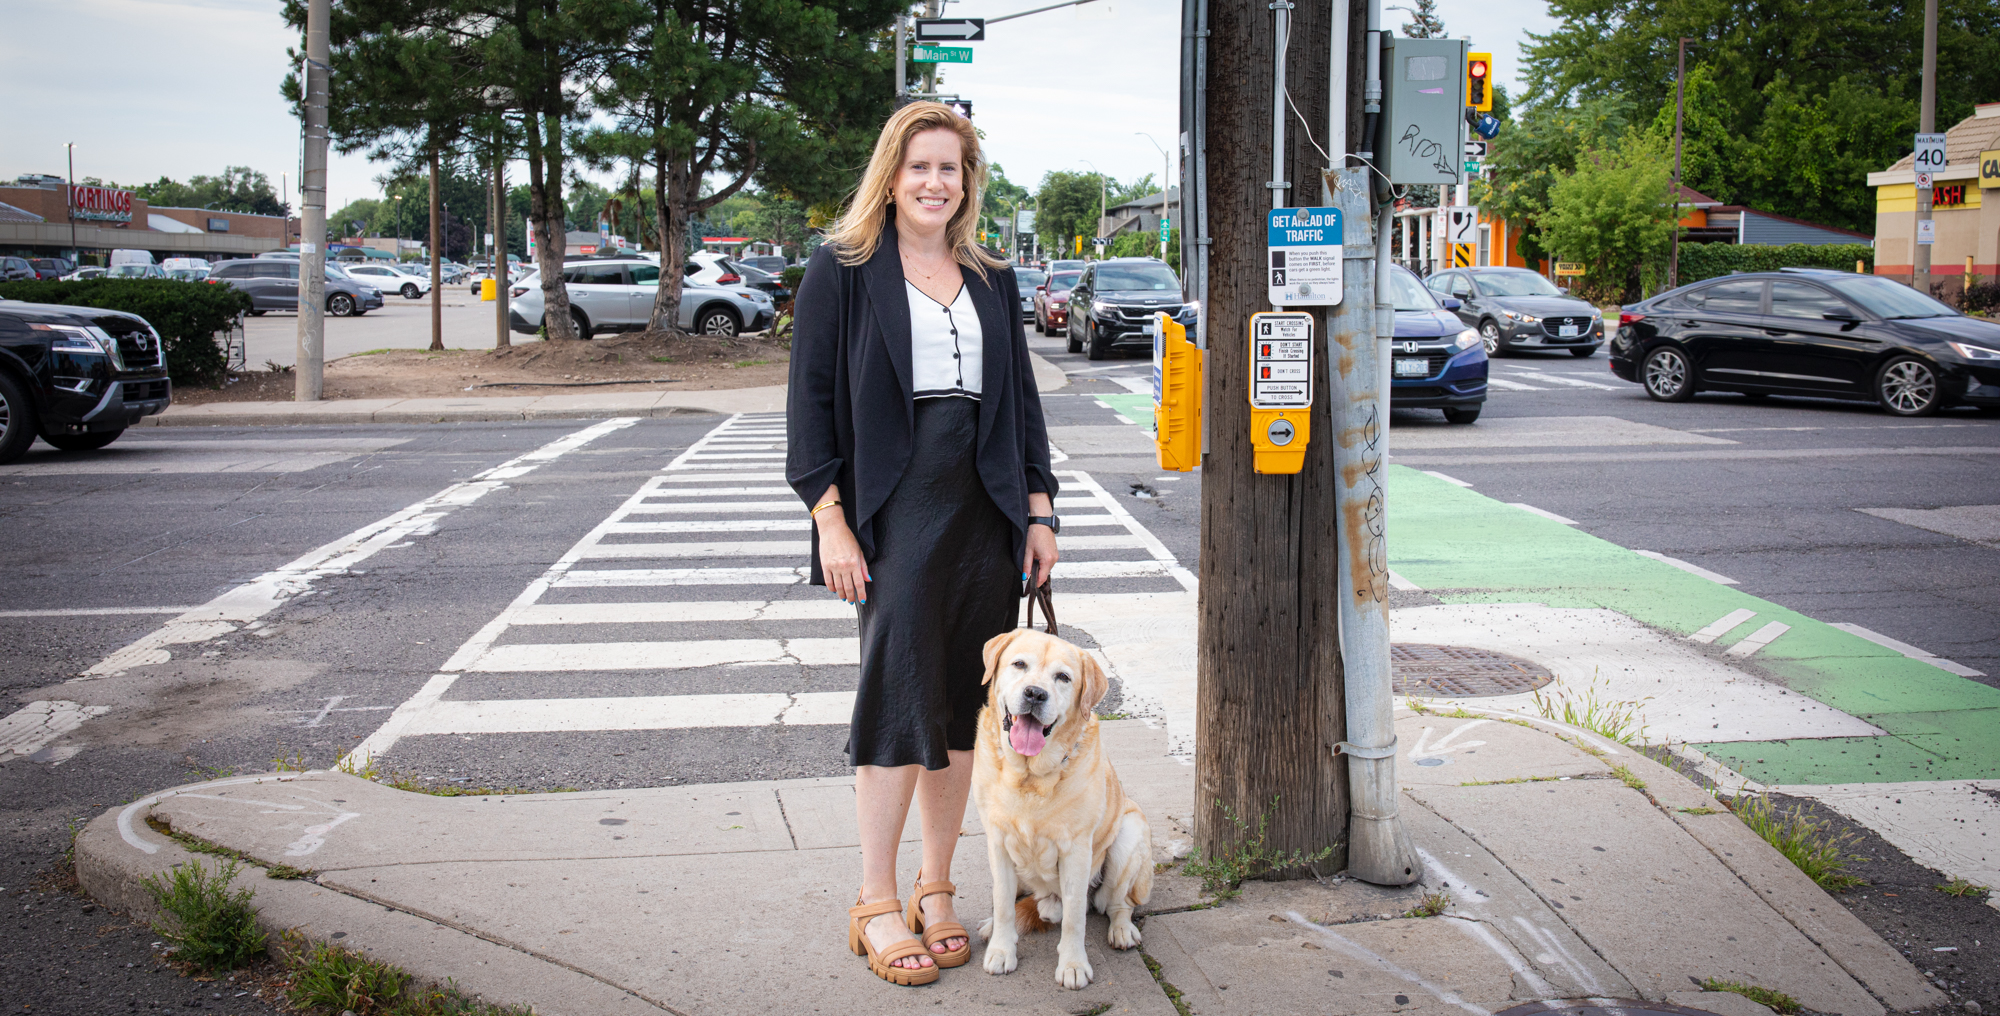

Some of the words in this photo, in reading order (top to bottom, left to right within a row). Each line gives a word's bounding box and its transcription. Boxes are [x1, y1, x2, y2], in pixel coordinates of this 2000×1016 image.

[923, 50, 949, 60] Main
[959, 51, 969, 61] W
[1916, 149, 1944, 166] 40
[1982, 160, 2000, 179] CA
[1932, 185, 1961, 206] ASH
[1272, 216, 1290, 228] GET
[1291, 215, 1322, 227] AHEAD
[1324, 214, 1336, 226] OF
[1286, 229, 1323, 242] TRAFFIC
